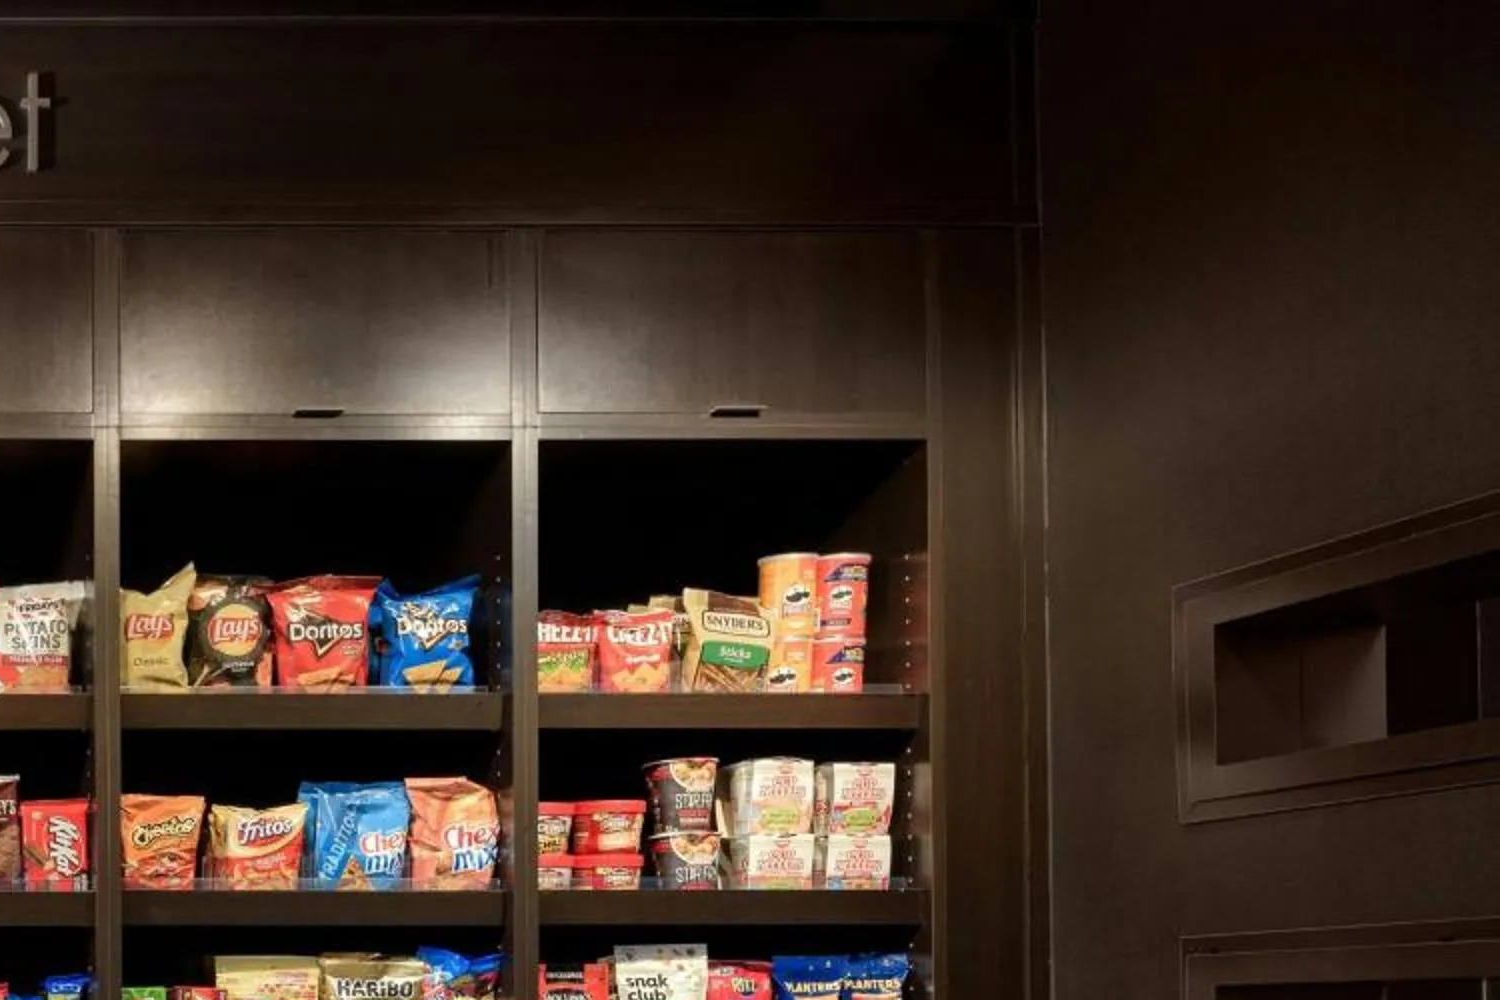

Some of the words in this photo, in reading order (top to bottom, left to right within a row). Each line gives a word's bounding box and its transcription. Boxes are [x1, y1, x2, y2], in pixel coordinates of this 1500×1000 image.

[4, 621, 68, 637] POTATO
[289, 622, 364, 641] Doritos
[397, 617, 468, 636] Doritos
[445, 821, 501, 850] Chex
[452, 847, 500, 873] mix
[337, 980, 414, 998] HARIBO
[625, 974, 669, 988] snak
